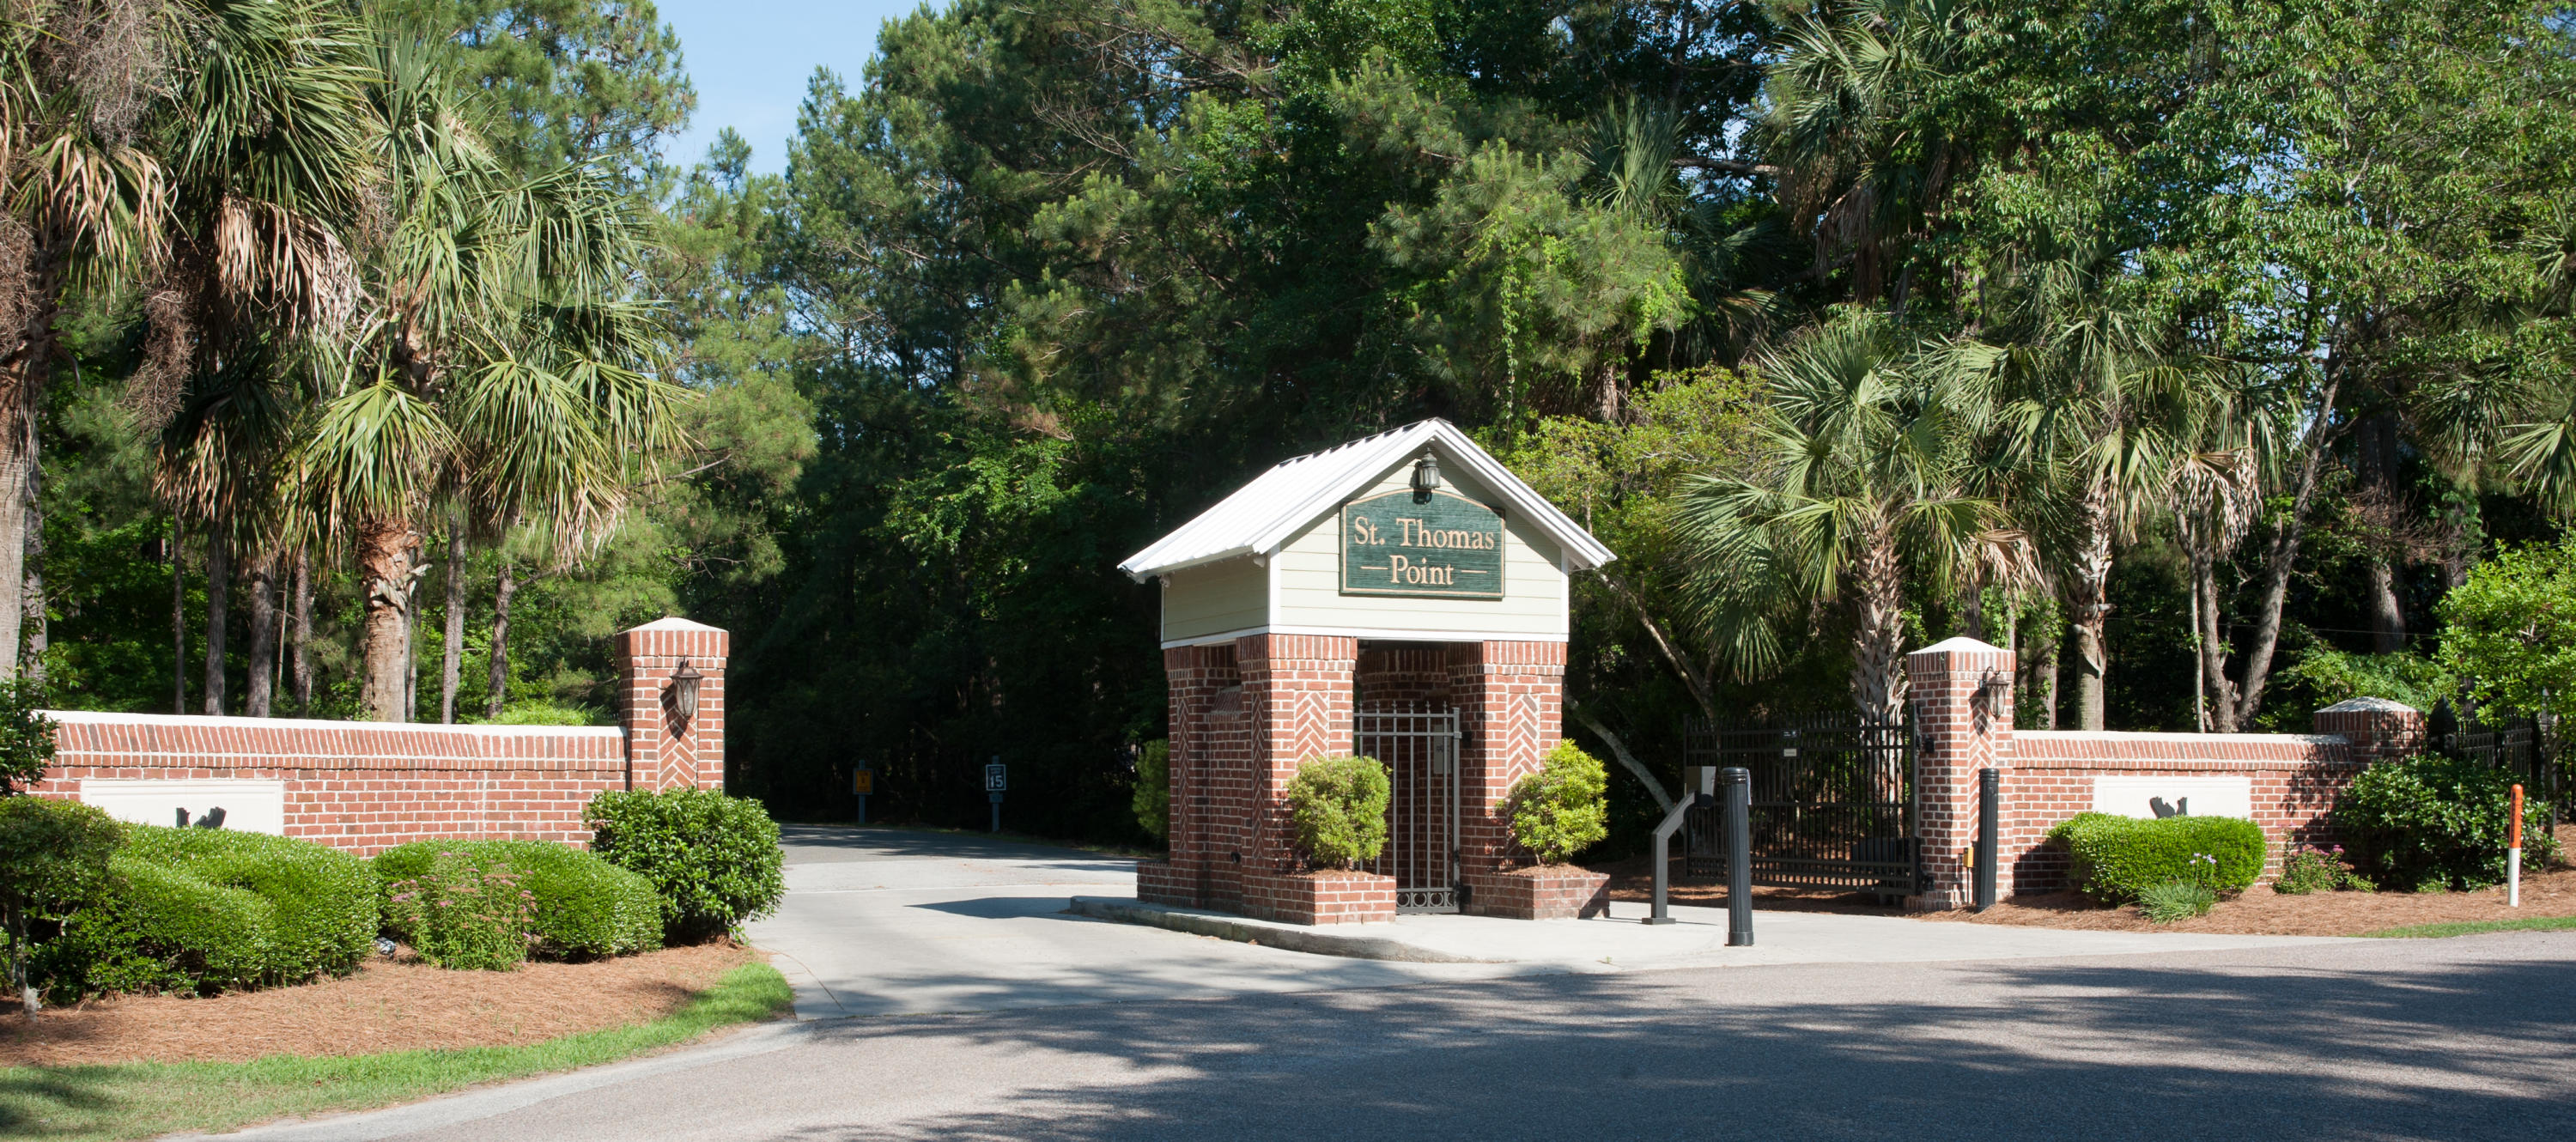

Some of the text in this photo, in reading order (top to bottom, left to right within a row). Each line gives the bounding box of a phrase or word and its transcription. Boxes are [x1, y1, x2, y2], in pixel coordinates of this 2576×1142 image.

[1354, 516, 1494, 550] St. Thomas
[1389, 555, 1454, 585] Point
[990, 774, 1004, 787] 15
